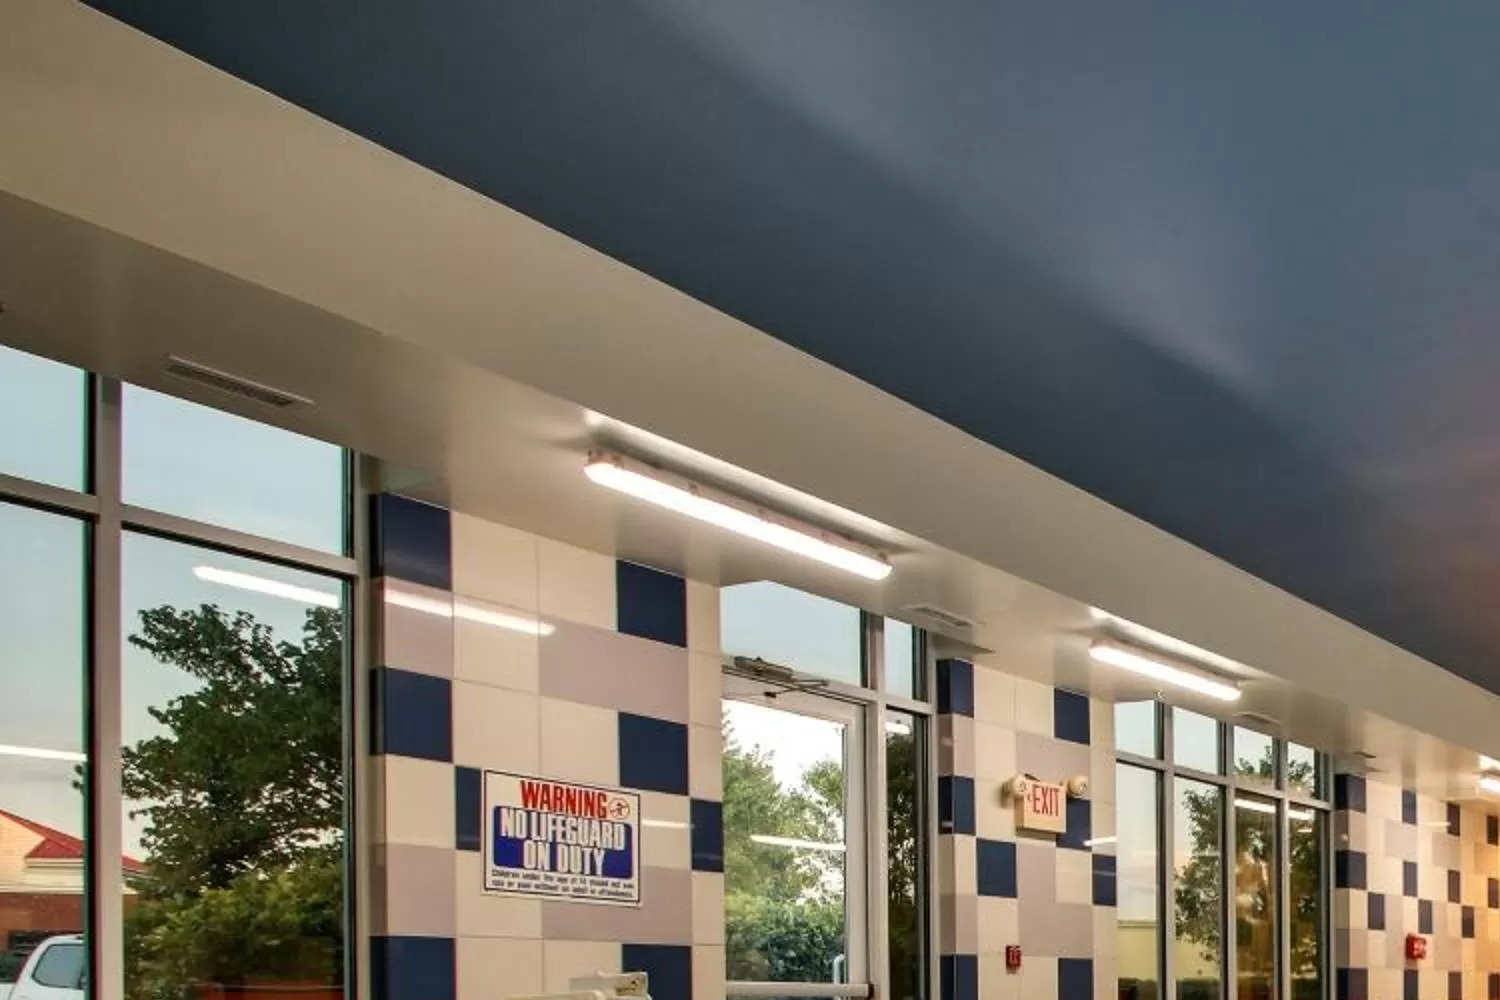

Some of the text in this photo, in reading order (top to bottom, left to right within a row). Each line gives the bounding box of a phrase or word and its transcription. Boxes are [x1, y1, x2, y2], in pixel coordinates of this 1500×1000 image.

[520, 780, 608, 819] WARNING
[1032, 784, 1060, 817] EXIT
[501, 807, 626, 851] NO LIFEGUARD
[523, 839, 606, 877] ON DUTY
